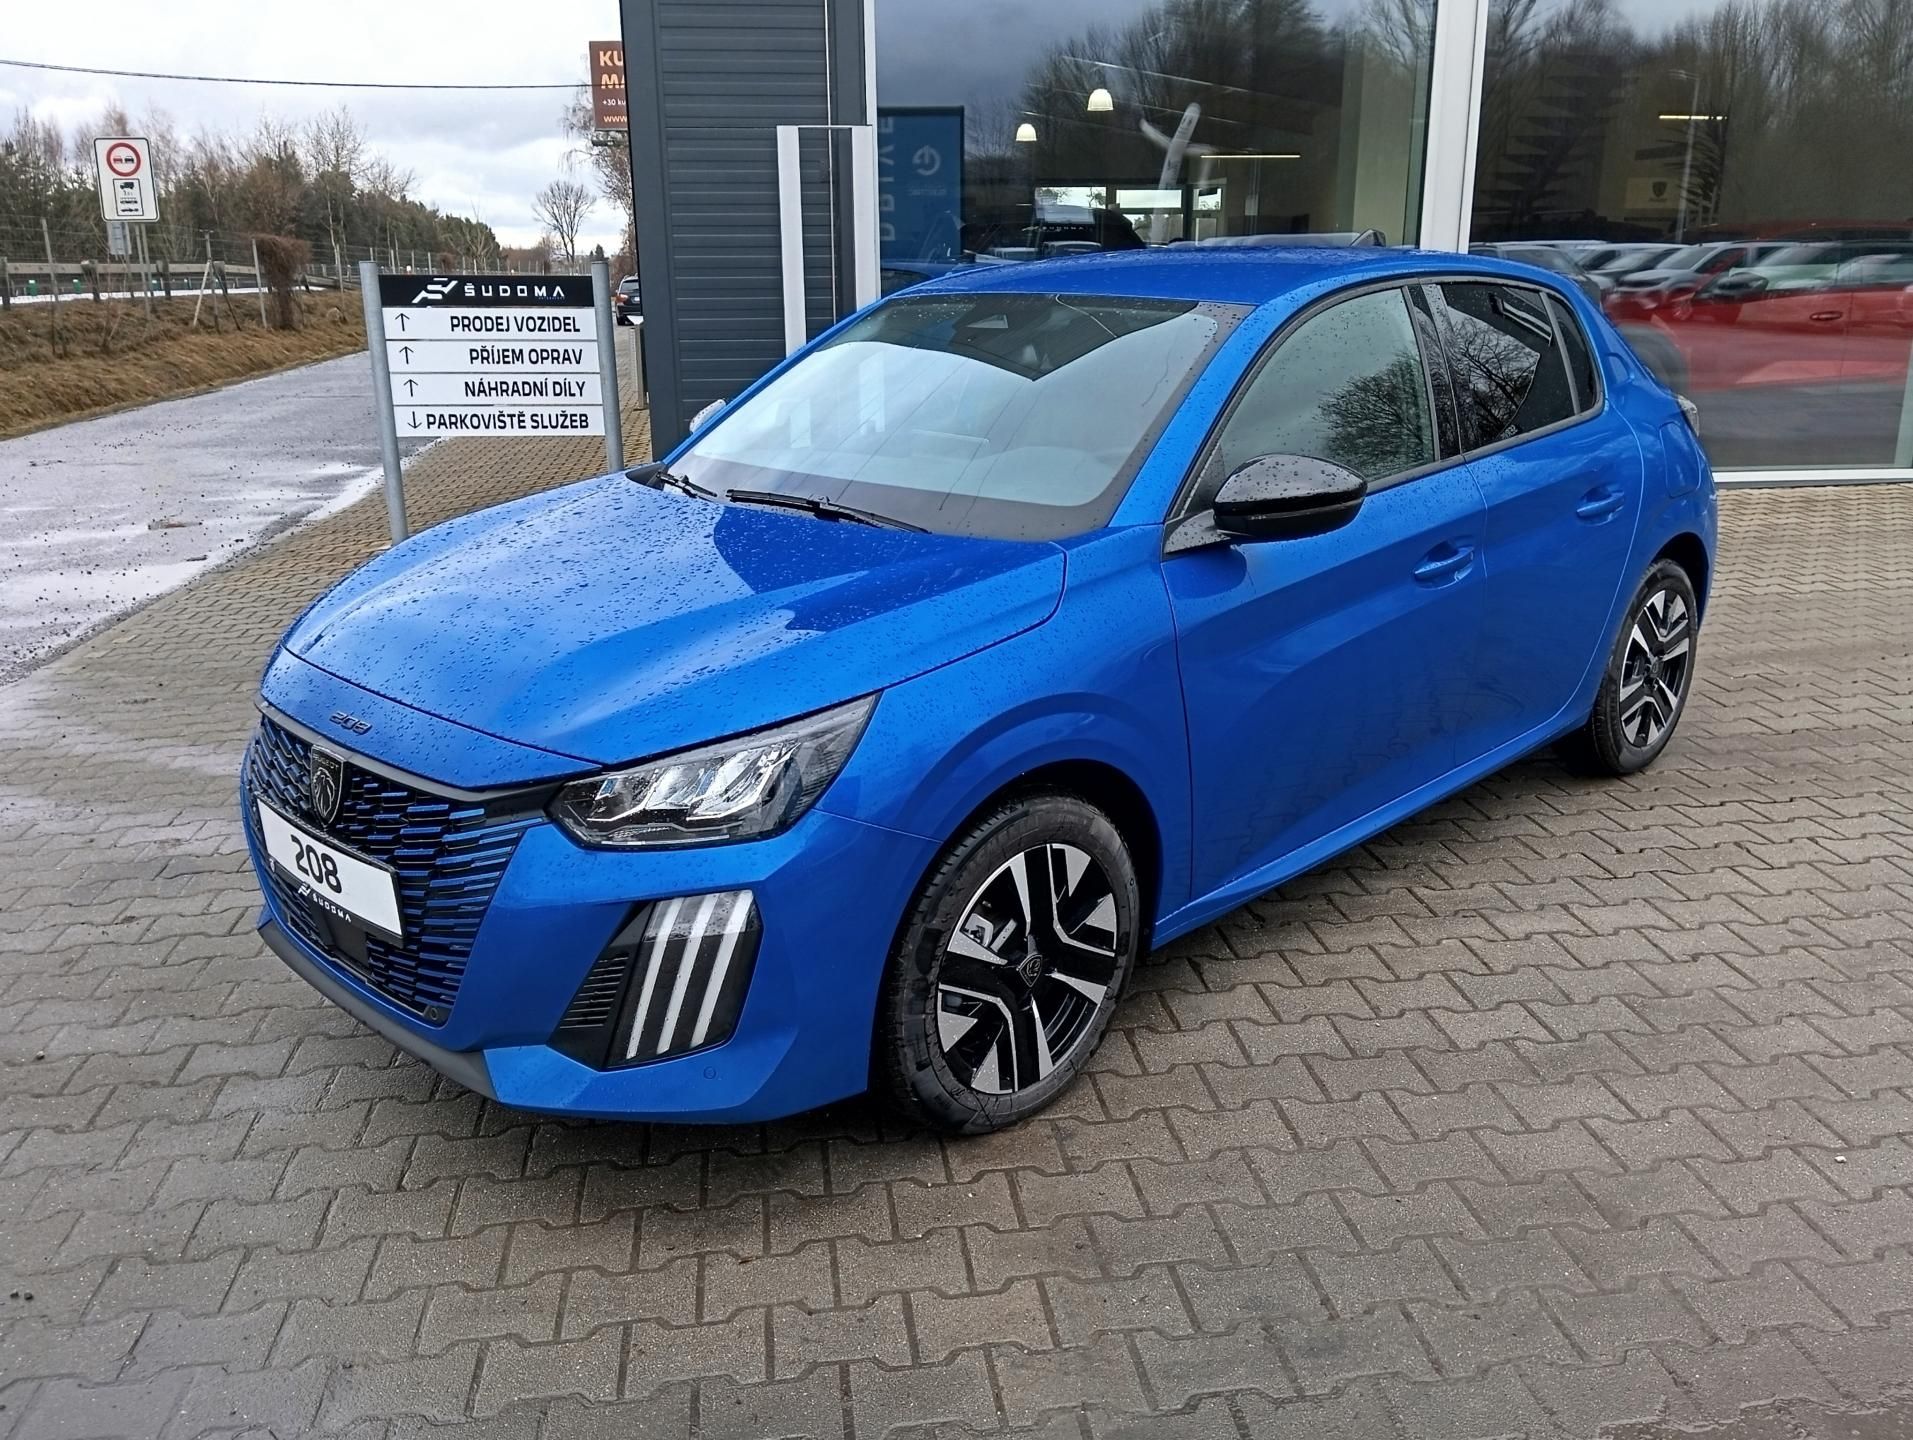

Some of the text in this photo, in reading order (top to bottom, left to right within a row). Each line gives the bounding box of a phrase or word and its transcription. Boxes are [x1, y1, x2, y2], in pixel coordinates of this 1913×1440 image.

[464, 282, 566, 298] ŠUDOMA
[450, 315, 581, 333] PRODEJ VOZIDEL
[469, 344, 583, 365] PŘÍJEM OPRAV
[464, 377, 586, 397] NÁHRADNÍ DÍLY
[426, 410, 589, 430] PARKOVIŠTĚ SLUŽEB
[329, 710, 373, 736] 208
[290, 833, 343, 894] 208
